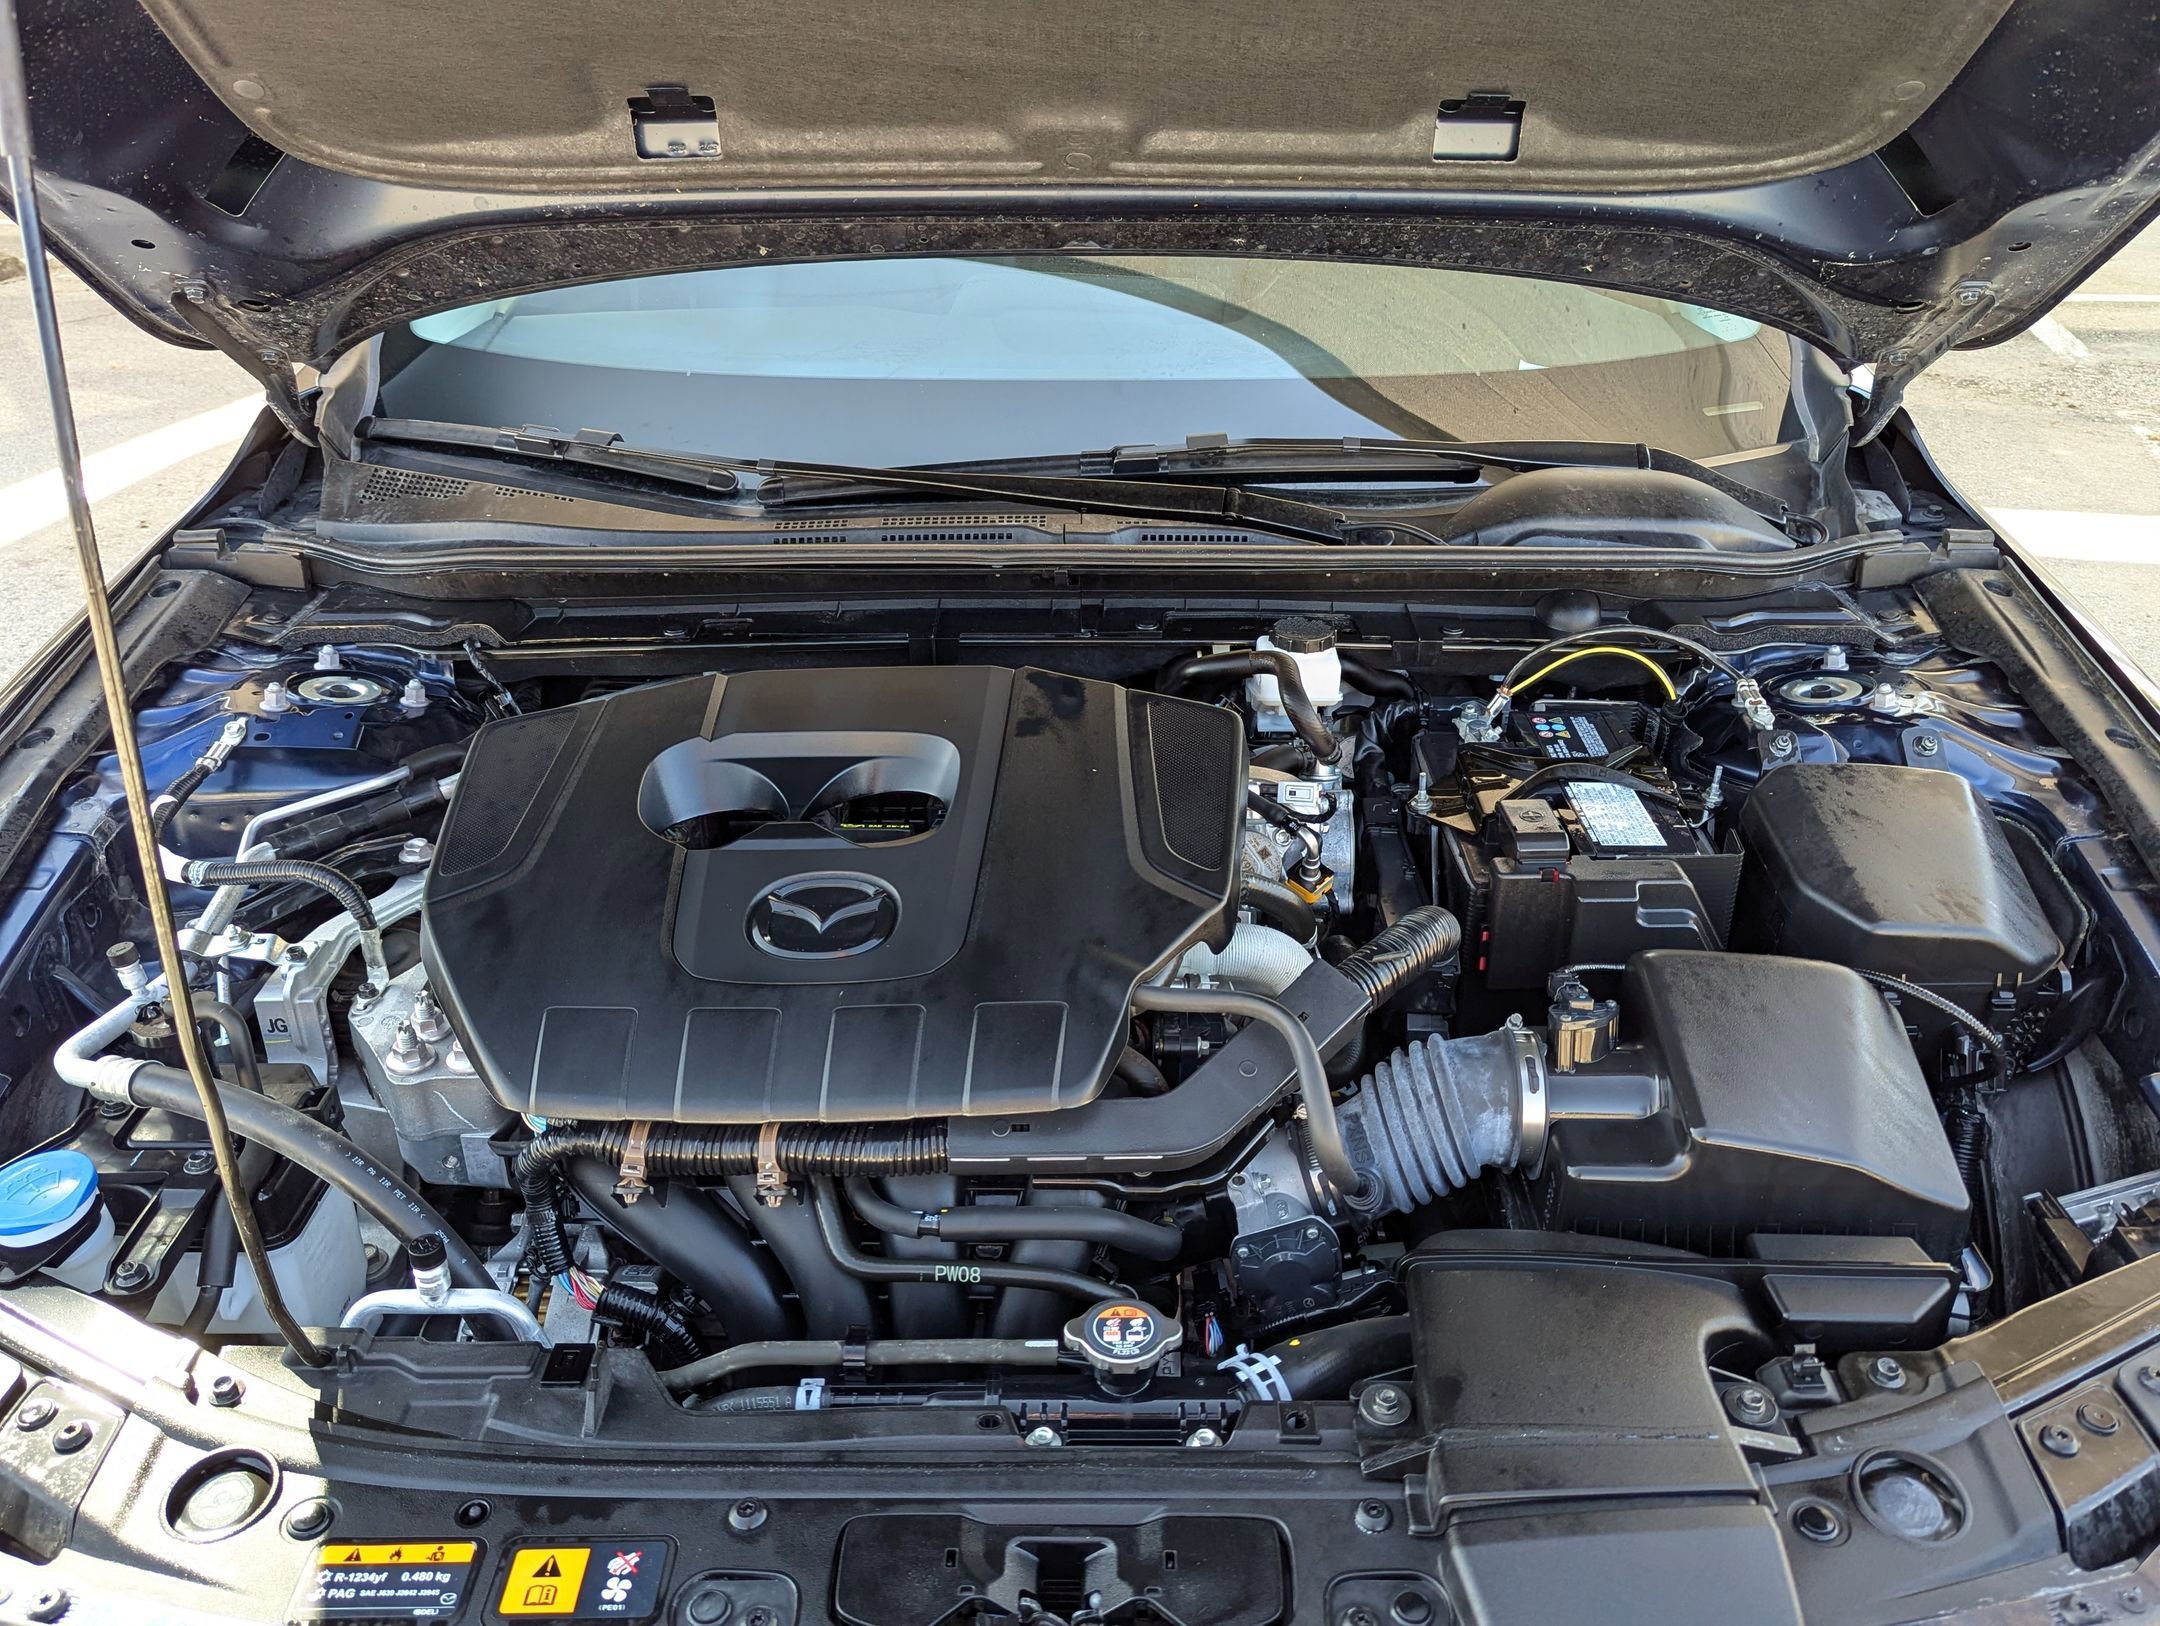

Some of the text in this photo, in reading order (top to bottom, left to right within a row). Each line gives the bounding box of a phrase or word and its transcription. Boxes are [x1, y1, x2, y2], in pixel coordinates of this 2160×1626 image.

[267, 1018, 288, 1033] JG
[393, 1188, 406, 1200] PET
[334, 1572, 451, 1584] R-1234yf 0.480 kg
[328, 1588, 356, 1599] PAG
[360, 1589, 376, 1597] SAE
